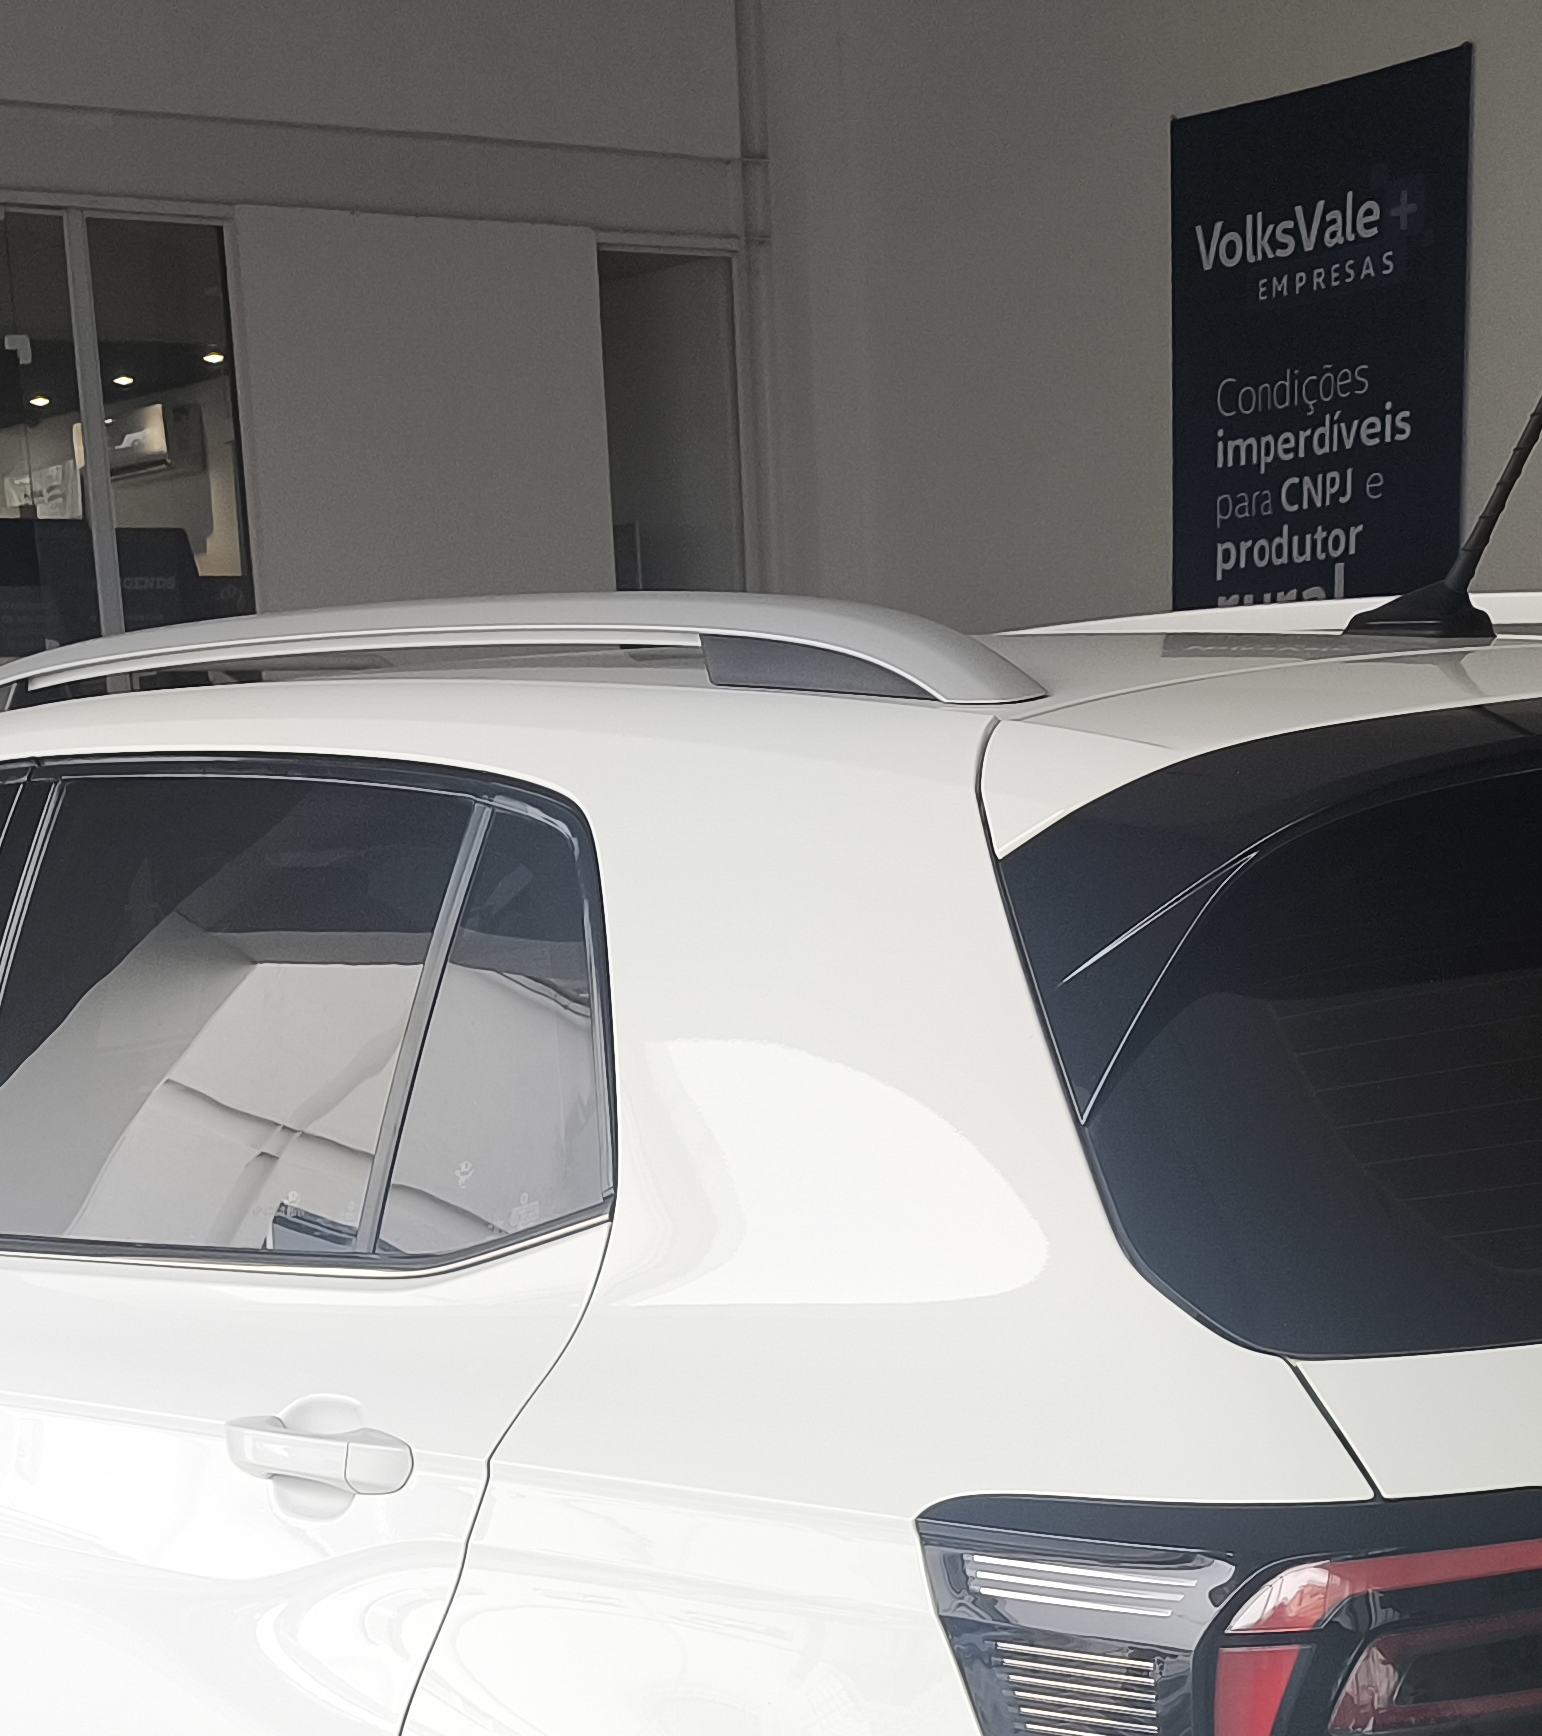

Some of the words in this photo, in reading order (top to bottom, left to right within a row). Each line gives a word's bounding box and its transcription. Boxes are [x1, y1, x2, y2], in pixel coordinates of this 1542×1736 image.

[1195, 190, 1381, 271] VolksVale
[1259, 251, 1394, 300] EMPRESAS
[1217, 364, 1369, 417] Condições
[1216, 401, 1411, 475] imperdíveis
[1216, 489, 1273, 529] para
[1280, 467, 1354, 512] CNPJ
[1365, 472, 1384, 499] e
[1216, 524, 1363, 581] produtor
